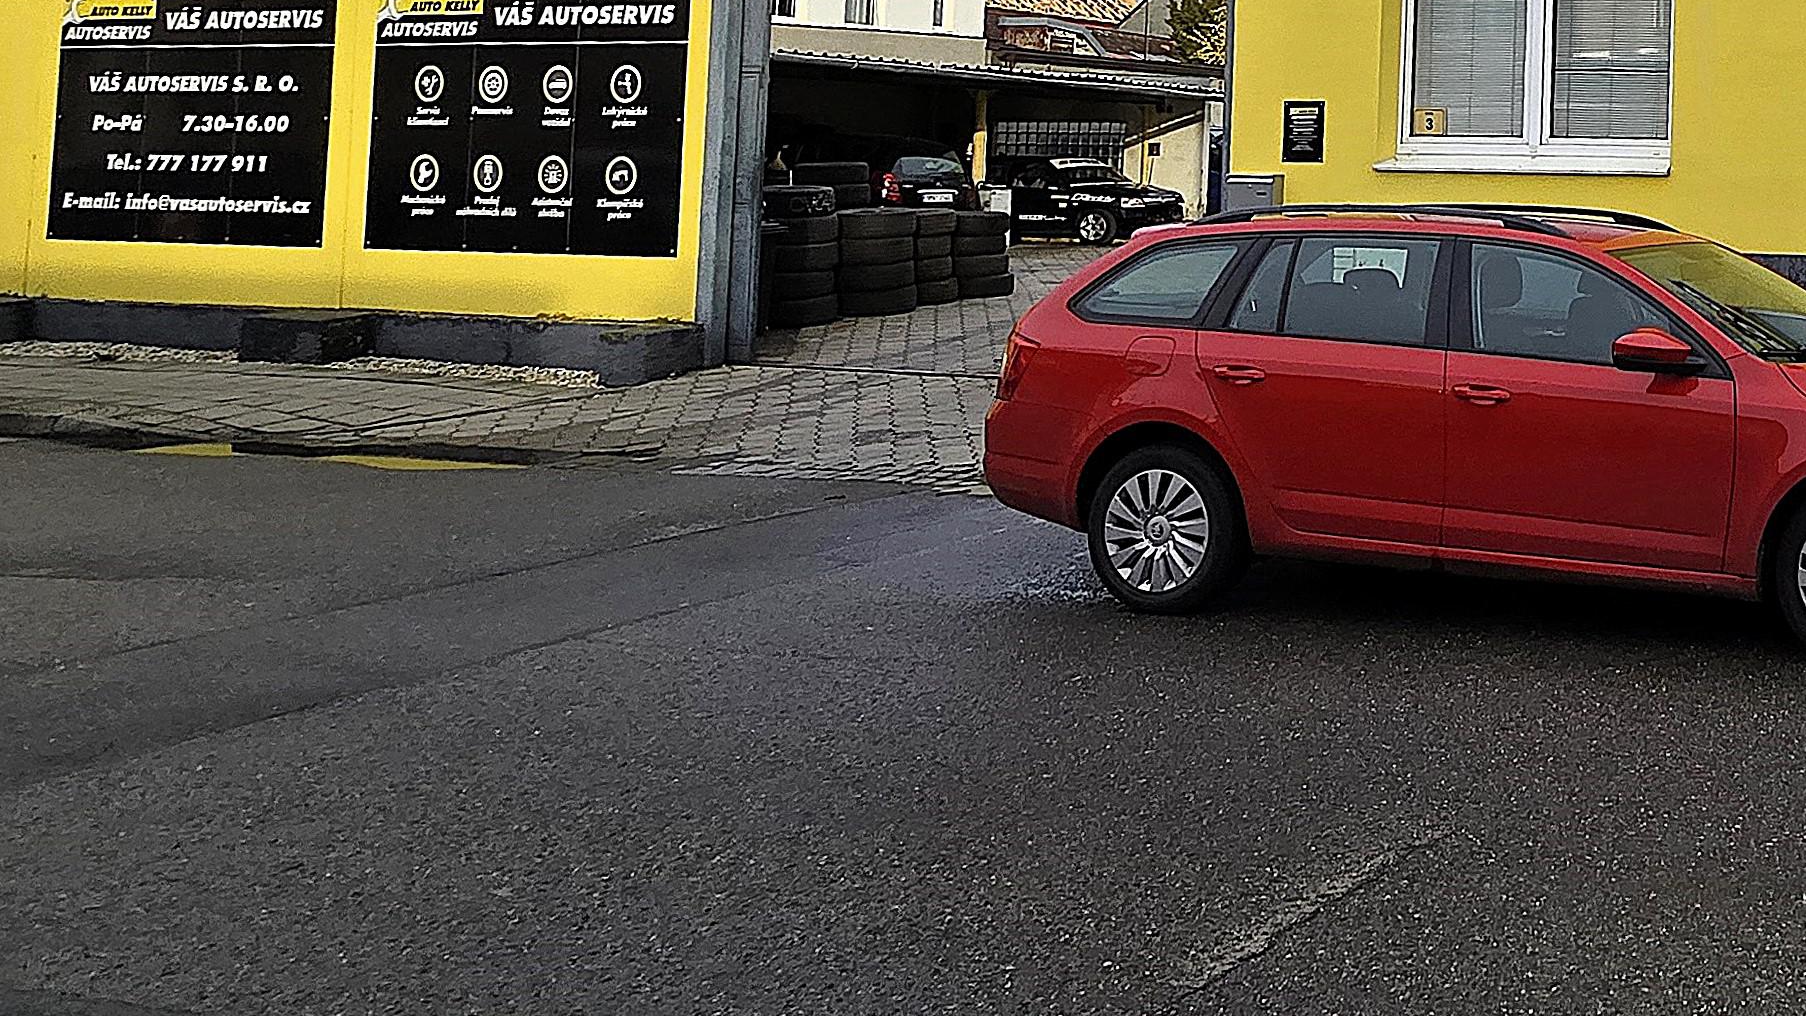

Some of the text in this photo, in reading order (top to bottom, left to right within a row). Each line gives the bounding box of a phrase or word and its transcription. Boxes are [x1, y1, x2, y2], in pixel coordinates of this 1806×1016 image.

[90, 6, 152, 16] AUTO KELLY
[410, 0, 479, 11] AUTO KELLY
[494, 1, 675, 25] VÁŠ AUTOSERVIS
[166, 7, 323, 29] VÁŠ AUTOSERVIS
[65, 26, 151, 40] AUTOSERVIS
[381, 21, 478, 37] AUTOSERVIS
[90, 71, 298, 92] VÁŠ AUTOSERVIS S. R. O.
[92, 114, 289, 132] Po-Pá 7.30-16.00
[1426, 118, 1433, 130] 3
[107, 153, 267, 172] Tel.: 777 177 911
[63, 192, 311, 213] E-mail: info@vasautoservis.cz
